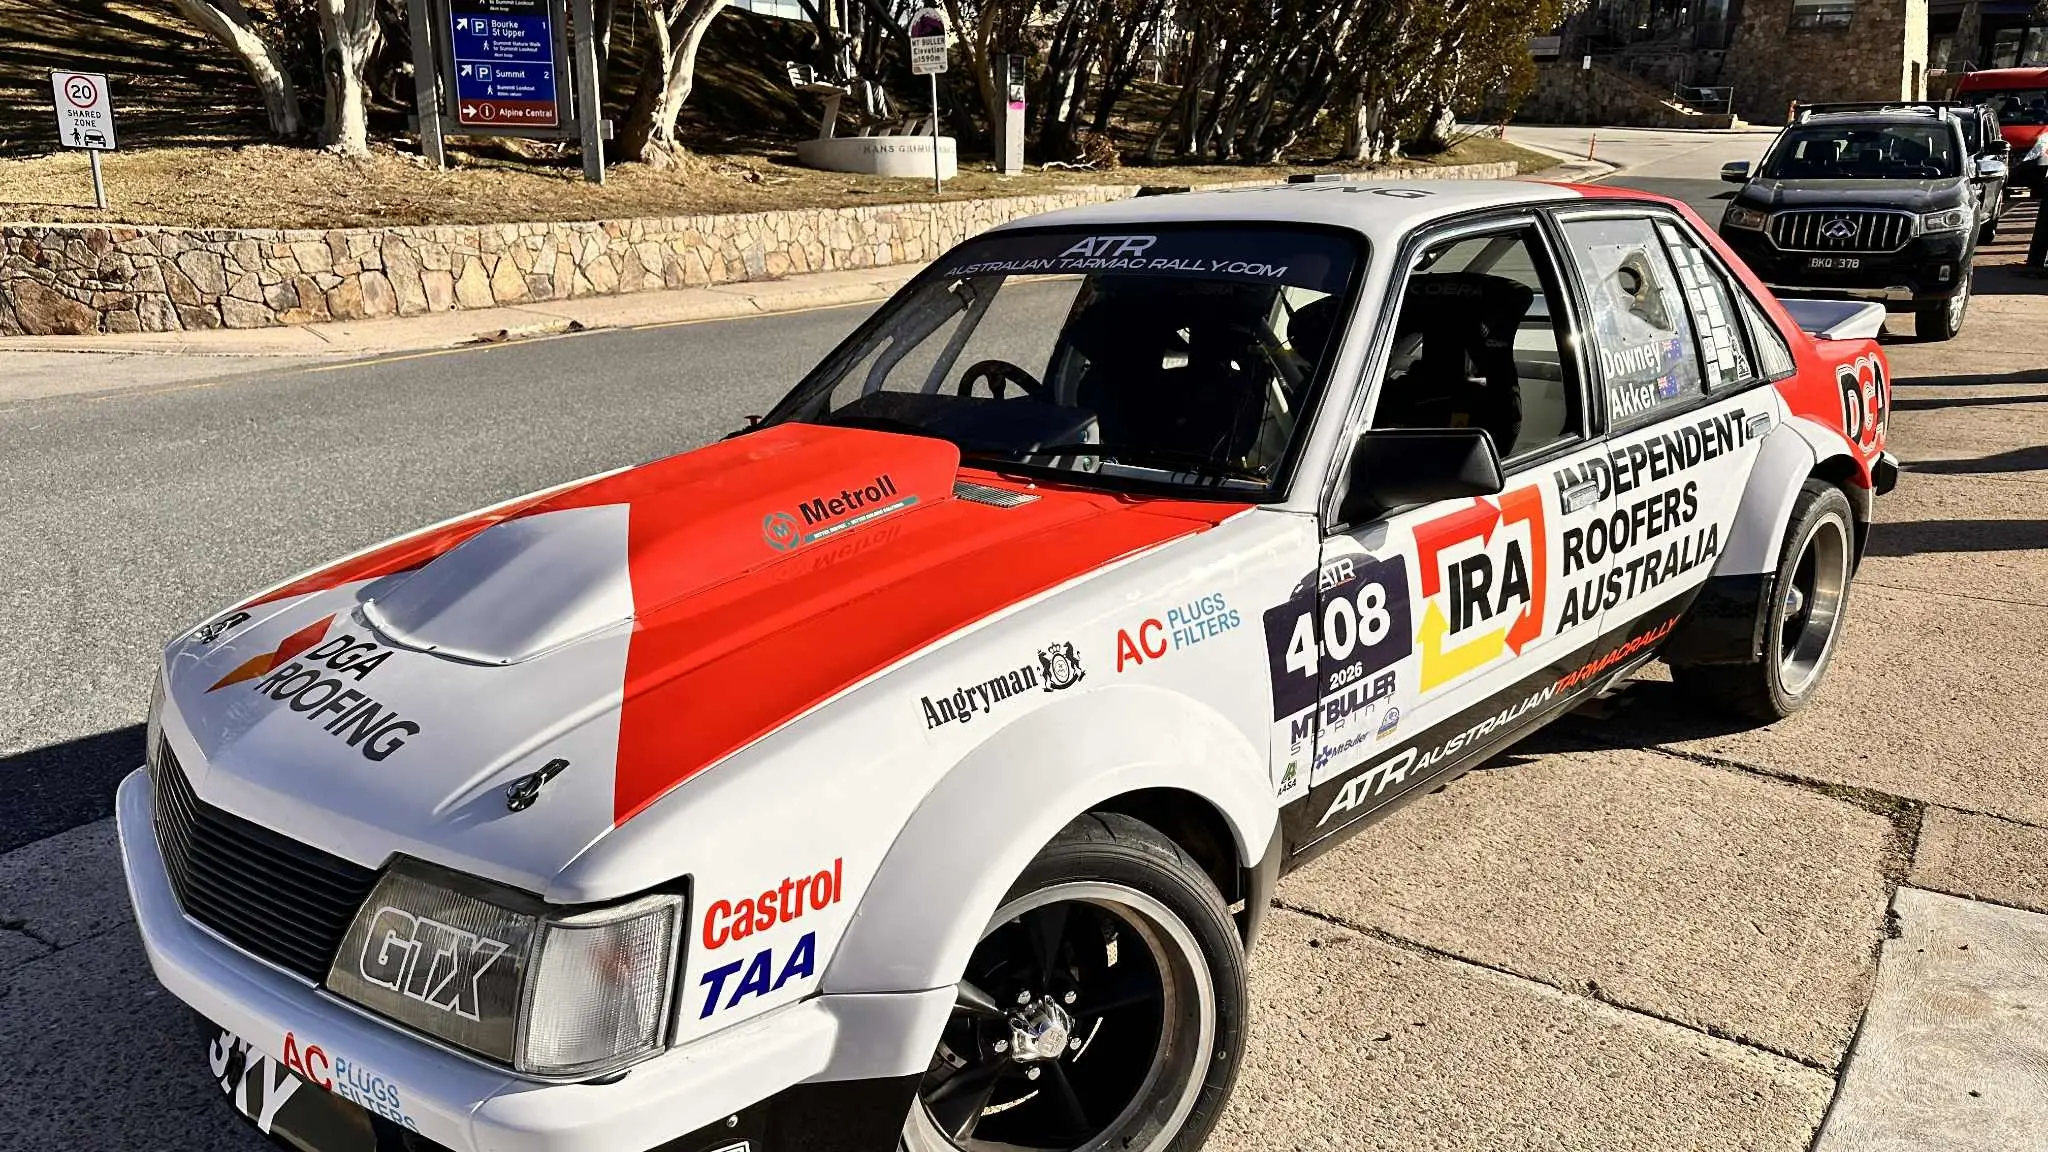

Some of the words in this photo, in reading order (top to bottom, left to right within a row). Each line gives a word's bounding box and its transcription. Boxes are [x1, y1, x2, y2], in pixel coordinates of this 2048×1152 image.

[491, 20, 519, 29] Bourke
[542, 21, 546, 30] 1
[492, 28, 501, 37] St
[502, 28, 526, 38] Upper
[71, 84, 92, 100] 20
[495, 69, 526, 79] Summit
[543, 71, 550, 79] 2
[67, 109, 102, 119] SHARED
[74, 118, 97, 128] ZONE
[499, 108, 524, 119] Alpine
[525, 108, 553, 118] Central
[945, 258, 1059, 277] AUSTRALIAN
[1058, 257, 1148, 270] TARMAC
[1148, 257, 1290, 279] RALLY.COM
[1059, 235, 1157, 258] ATR
[1838, 258, 1860, 269] 378
[1600, 341, 1662, 380] Downey
[1611, 382, 1656, 420] Akker
[798, 474, 898, 526] Metroll
[1562, 480, 1699, 577] ROOFERS
[1447, 539, 1532, 636] IRA
[1555, 522, 1719, 637] AUSTRALIA
[1167, 591, 1227, 630] PLUGS
[1172, 609, 1242, 651] FILTERS
[1285, 582, 1391, 679] 408
[304, 634, 394, 682] DGA
[1115, 618, 1168, 674] AC
[920, 662, 1040, 730] Angryman
[1329, 660, 1364, 691] 2026
[252, 661, 421, 762] ROOFING
[1315, 746, 1419, 828] ATR
[702, 856, 843, 950] Castrol
[359, 905, 510, 1022] GTX
[699, 930, 816, 1021] TAA
[283, 1031, 333, 1091] AC
[335, 1056, 401, 1109] PLUGS
